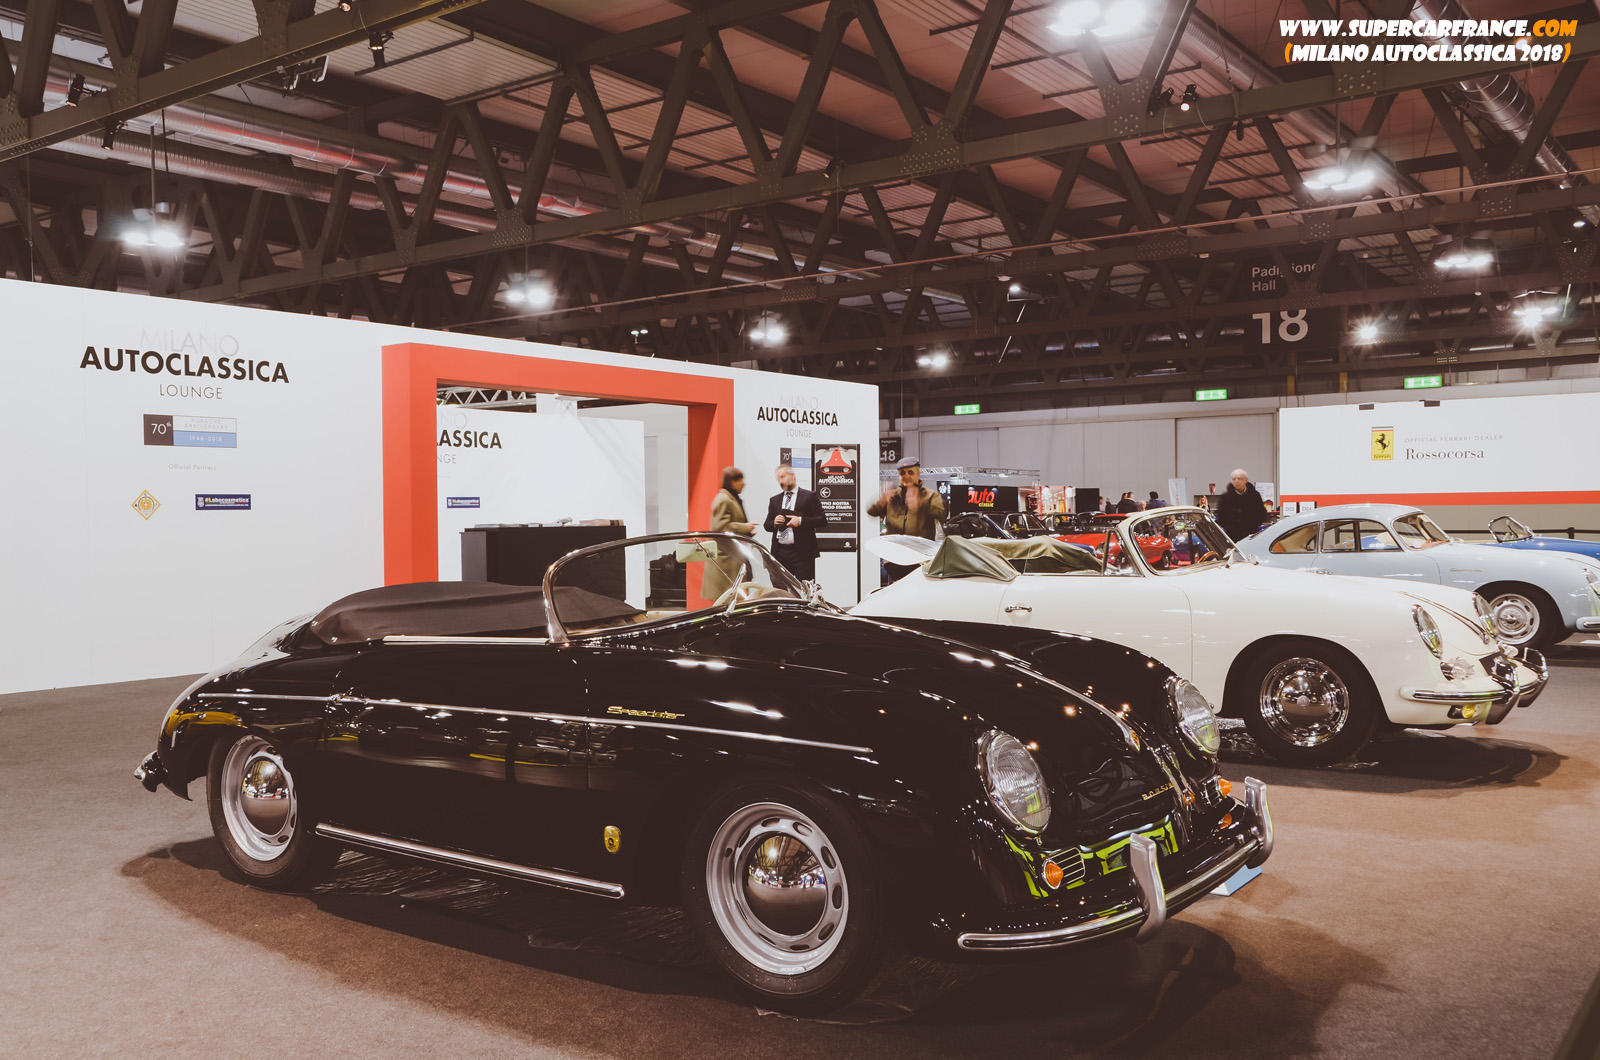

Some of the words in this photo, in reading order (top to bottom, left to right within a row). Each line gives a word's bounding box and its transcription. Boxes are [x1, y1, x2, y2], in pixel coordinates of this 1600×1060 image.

[1252, 279, 1276, 292] Hall
[1252, 309, 1308, 344] 18
[140, 327, 239, 357] MILANO
[79, 345, 290, 383] AUTOCLASSICA
[159, 383, 223, 399] LOUNGE
[757, 406, 839, 426] AUTOCLASSICA
[437, 429, 502, 449] ASSICA
[786, 428, 812, 438] LOUNGE
[882, 449, 896, 462] 18
[1406, 448, 1485, 460] Rossocorsa
